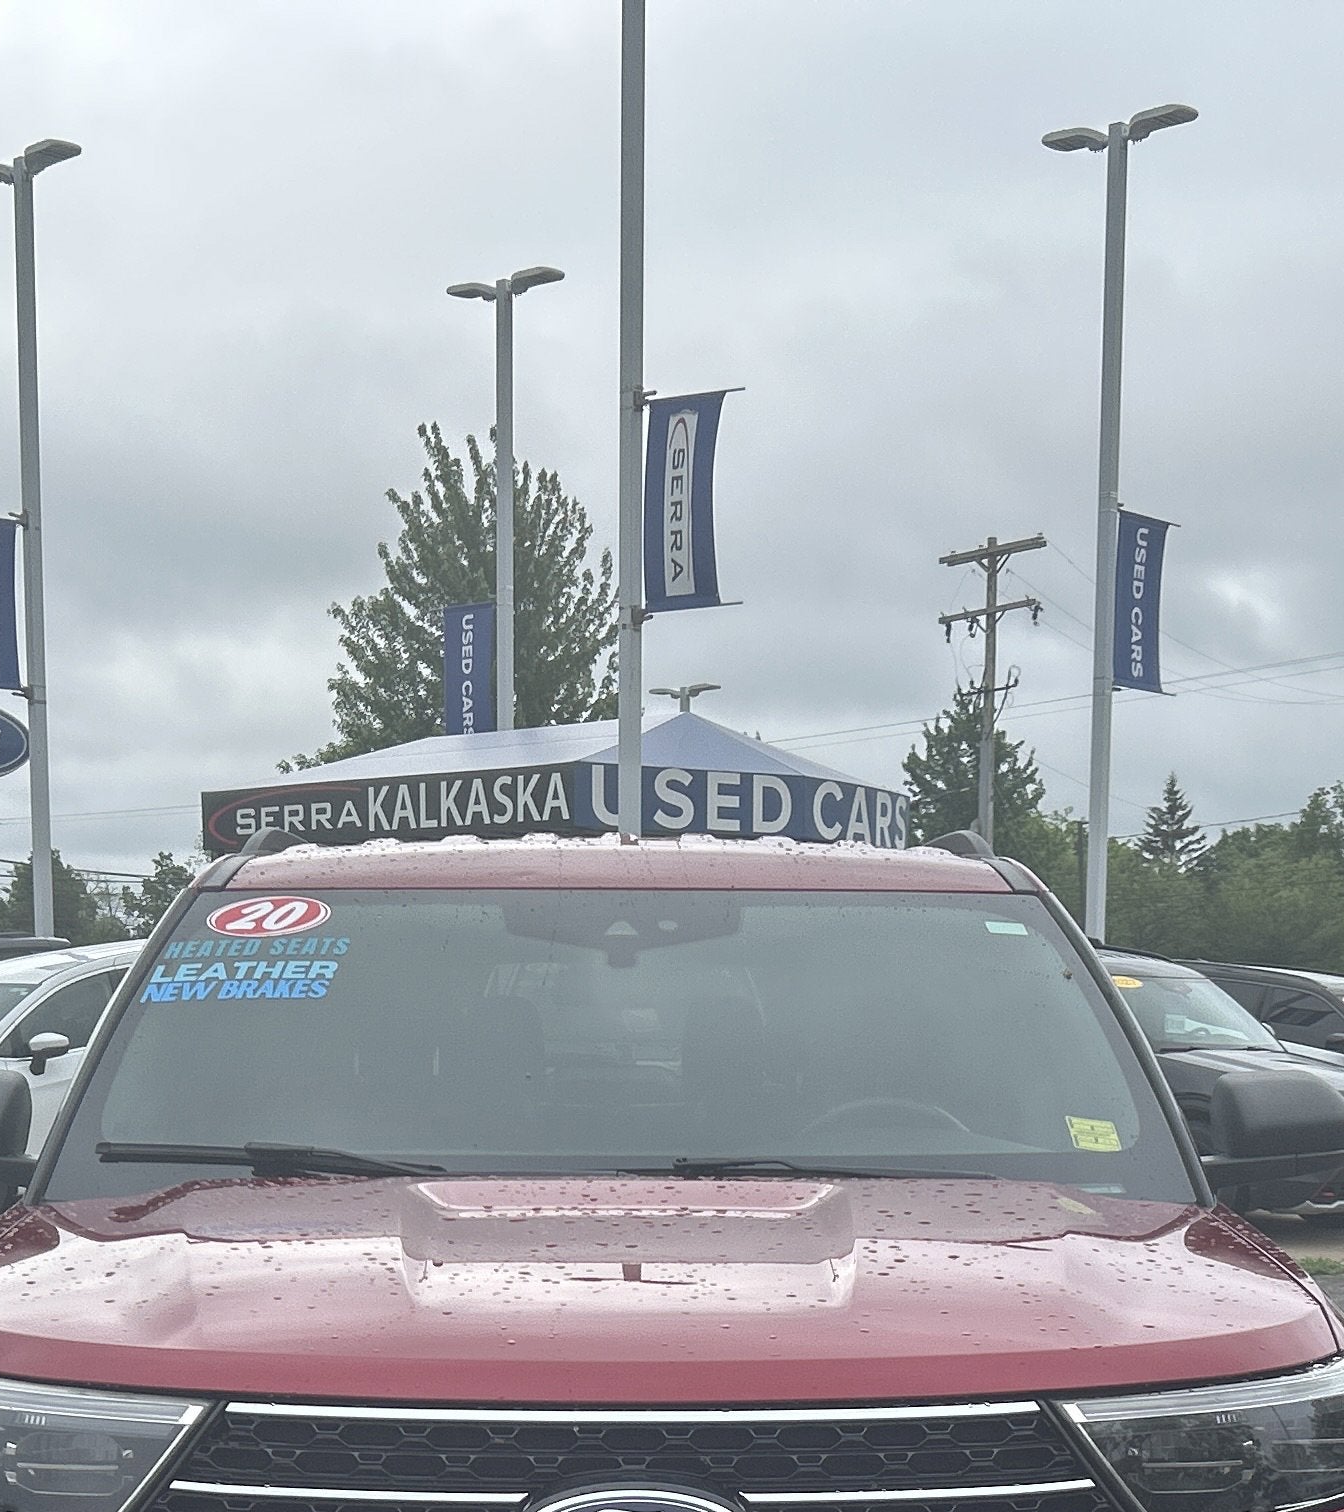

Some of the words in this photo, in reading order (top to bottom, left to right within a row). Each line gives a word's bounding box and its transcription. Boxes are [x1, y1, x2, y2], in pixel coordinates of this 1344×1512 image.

[670, 447, 685, 583] SERRA
[1131, 527, 1150, 600] USED
[461, 613, 474, 675] USED
[1130, 606, 1144, 678] CARS
[236, 800, 363, 836] SERRA
[367, 772, 571, 832] KALKASKA
[591, 764, 793, 834] USED
[812, 780, 907, 850] CARS
[225, 901, 309, 931] 20
[149, 960, 339, 984] LEATHER
[163, 938, 261, 960] HEATED
[269, 936, 352, 957] SEATS
[140, 980, 218, 1003] NEW
[217, 979, 330, 1000] BRAKES
